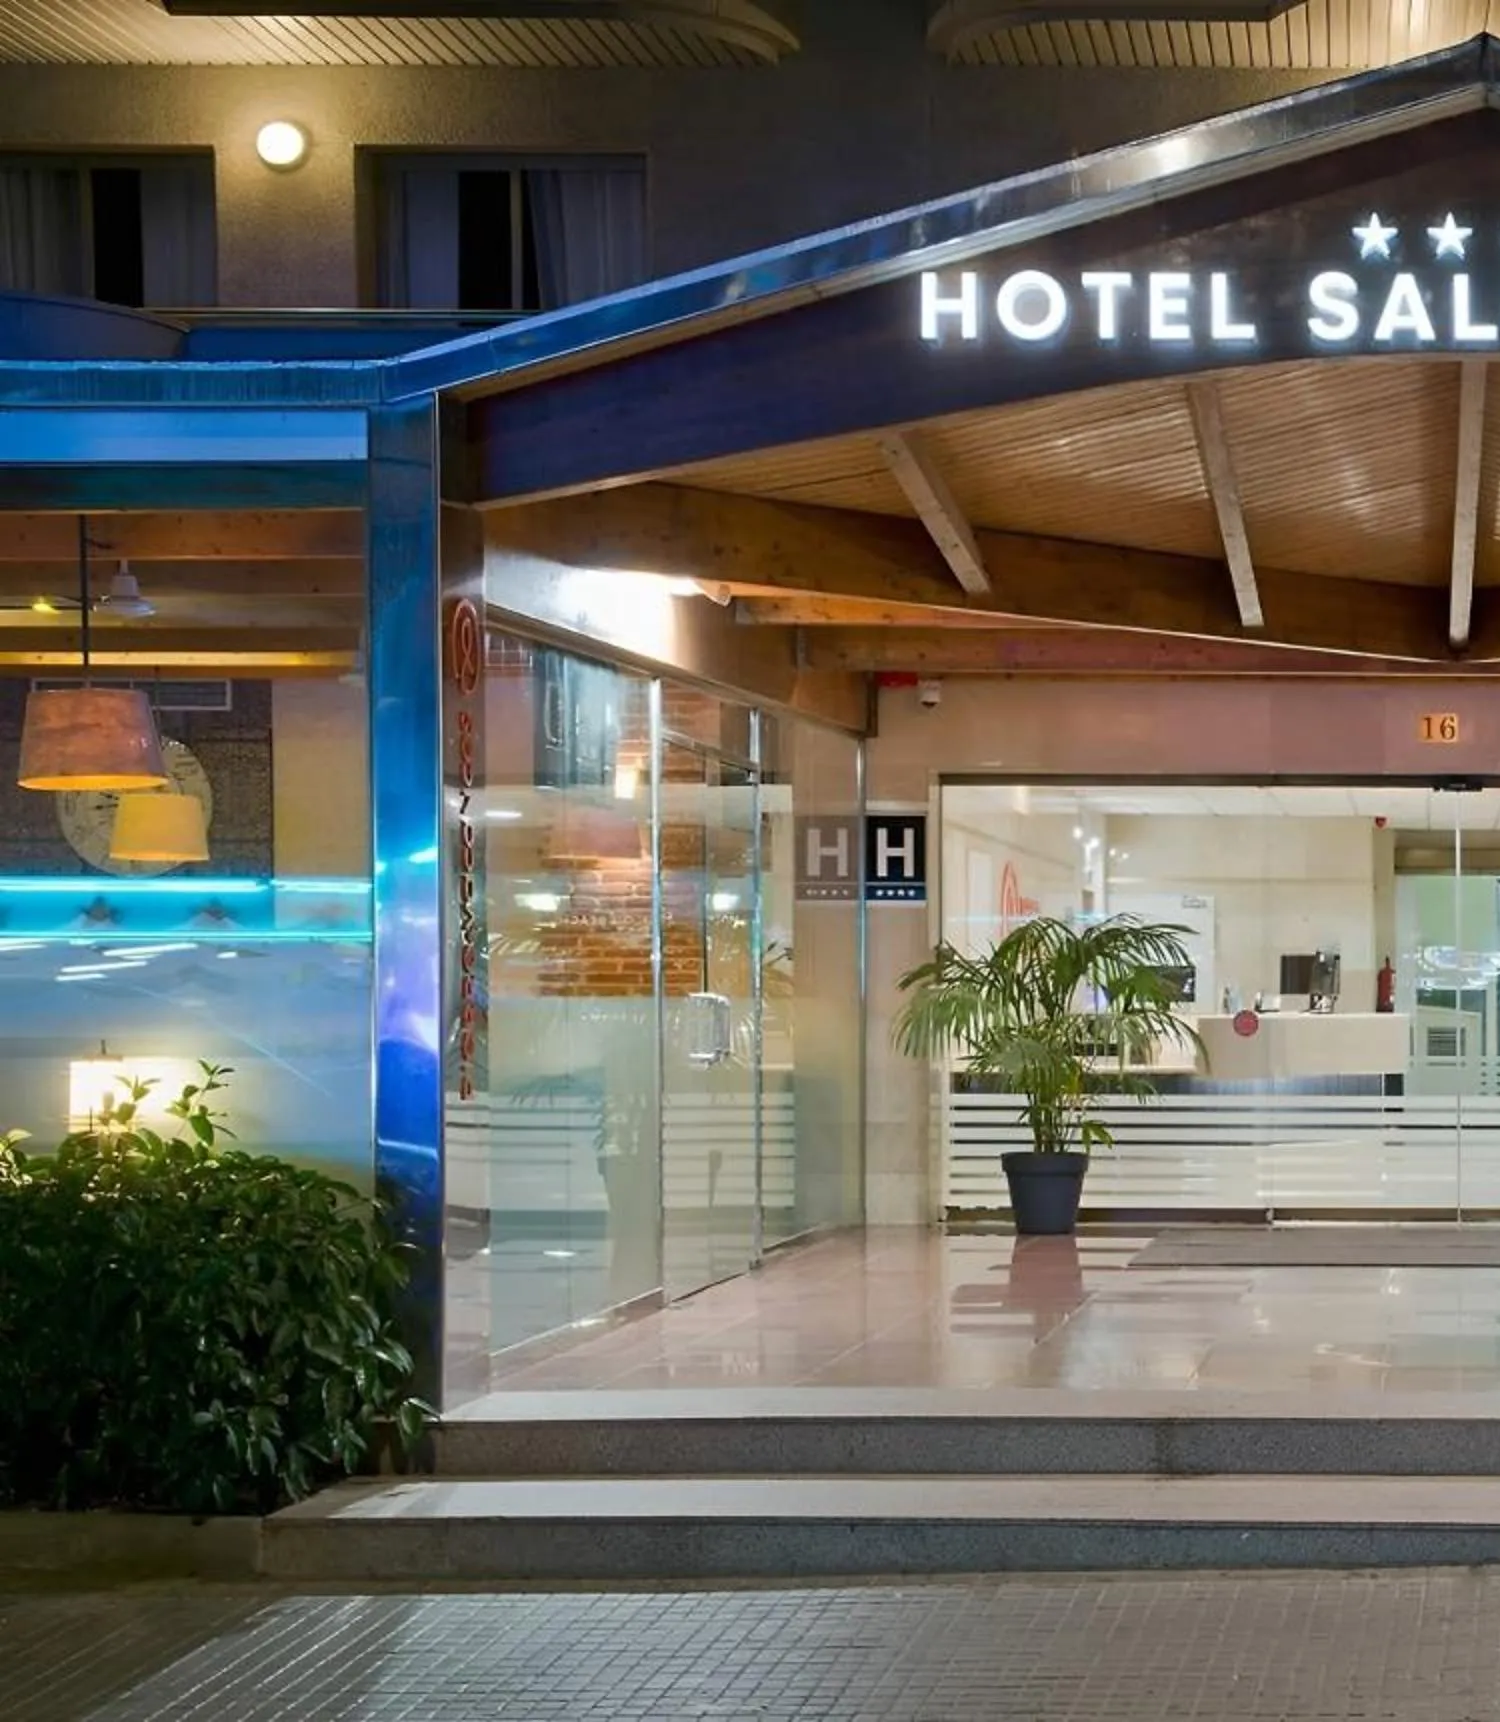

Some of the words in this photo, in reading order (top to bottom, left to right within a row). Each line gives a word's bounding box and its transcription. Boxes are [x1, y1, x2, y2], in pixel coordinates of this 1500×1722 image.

[920, 269, 1257, 342] HOTEL
[1423, 716, 1455, 740] 16
[876, 827, 915, 877] H
